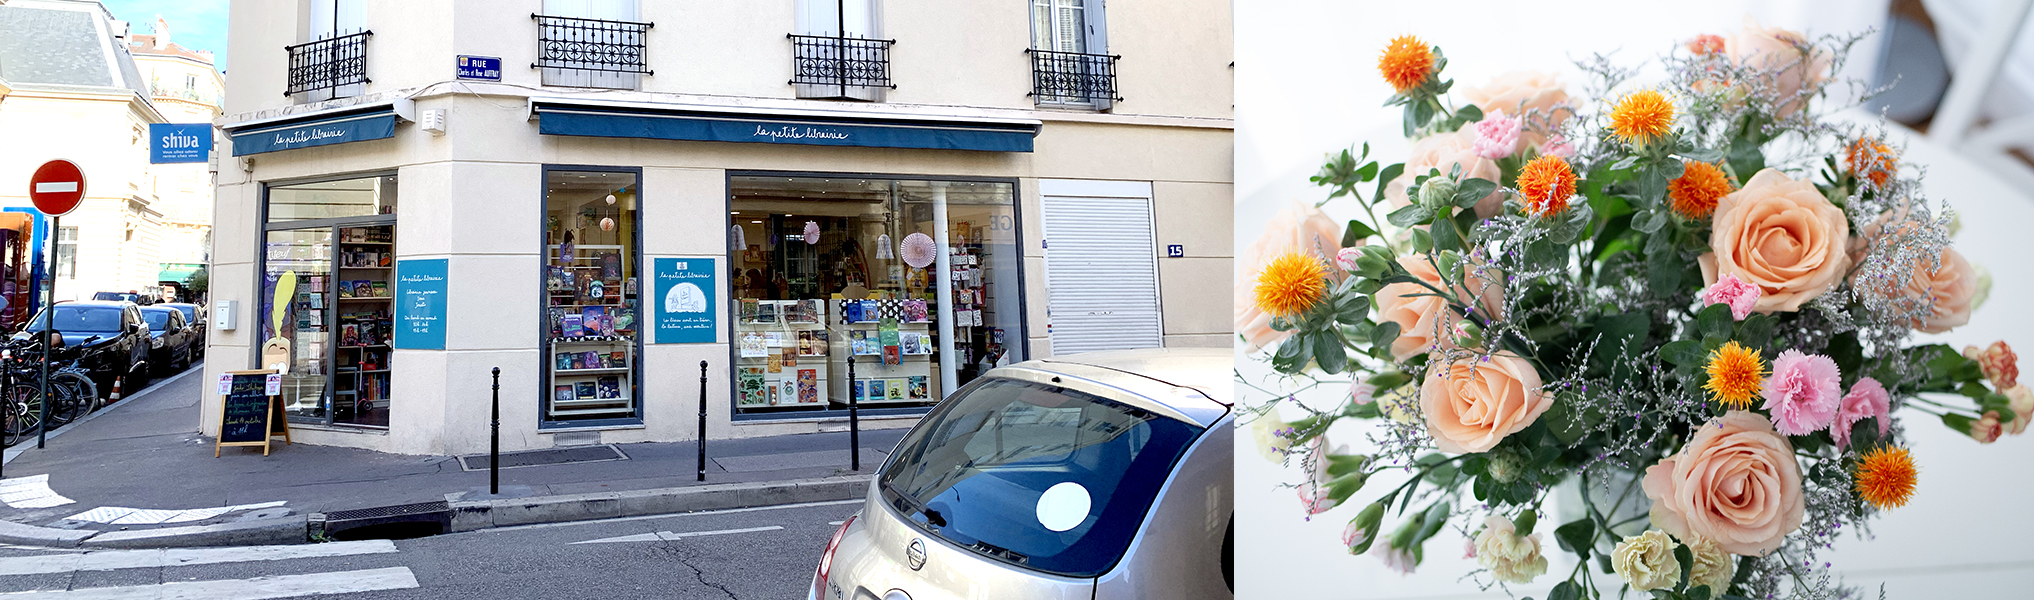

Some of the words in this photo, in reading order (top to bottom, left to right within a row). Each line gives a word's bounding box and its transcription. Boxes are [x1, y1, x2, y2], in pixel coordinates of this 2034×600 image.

[472, 59, 487, 68] RUE
[162, 129, 200, 148] shiva
[274, 132, 285, 145] la
[284, 130, 311, 148] petite
[311, 127, 346, 140] librairie
[754, 124, 770, 136] la
[770, 126, 806, 142] petite
[805, 127, 849, 140] librairie
[1170, 246, 1182, 256] 15
[668, 271, 687, 280] petite
